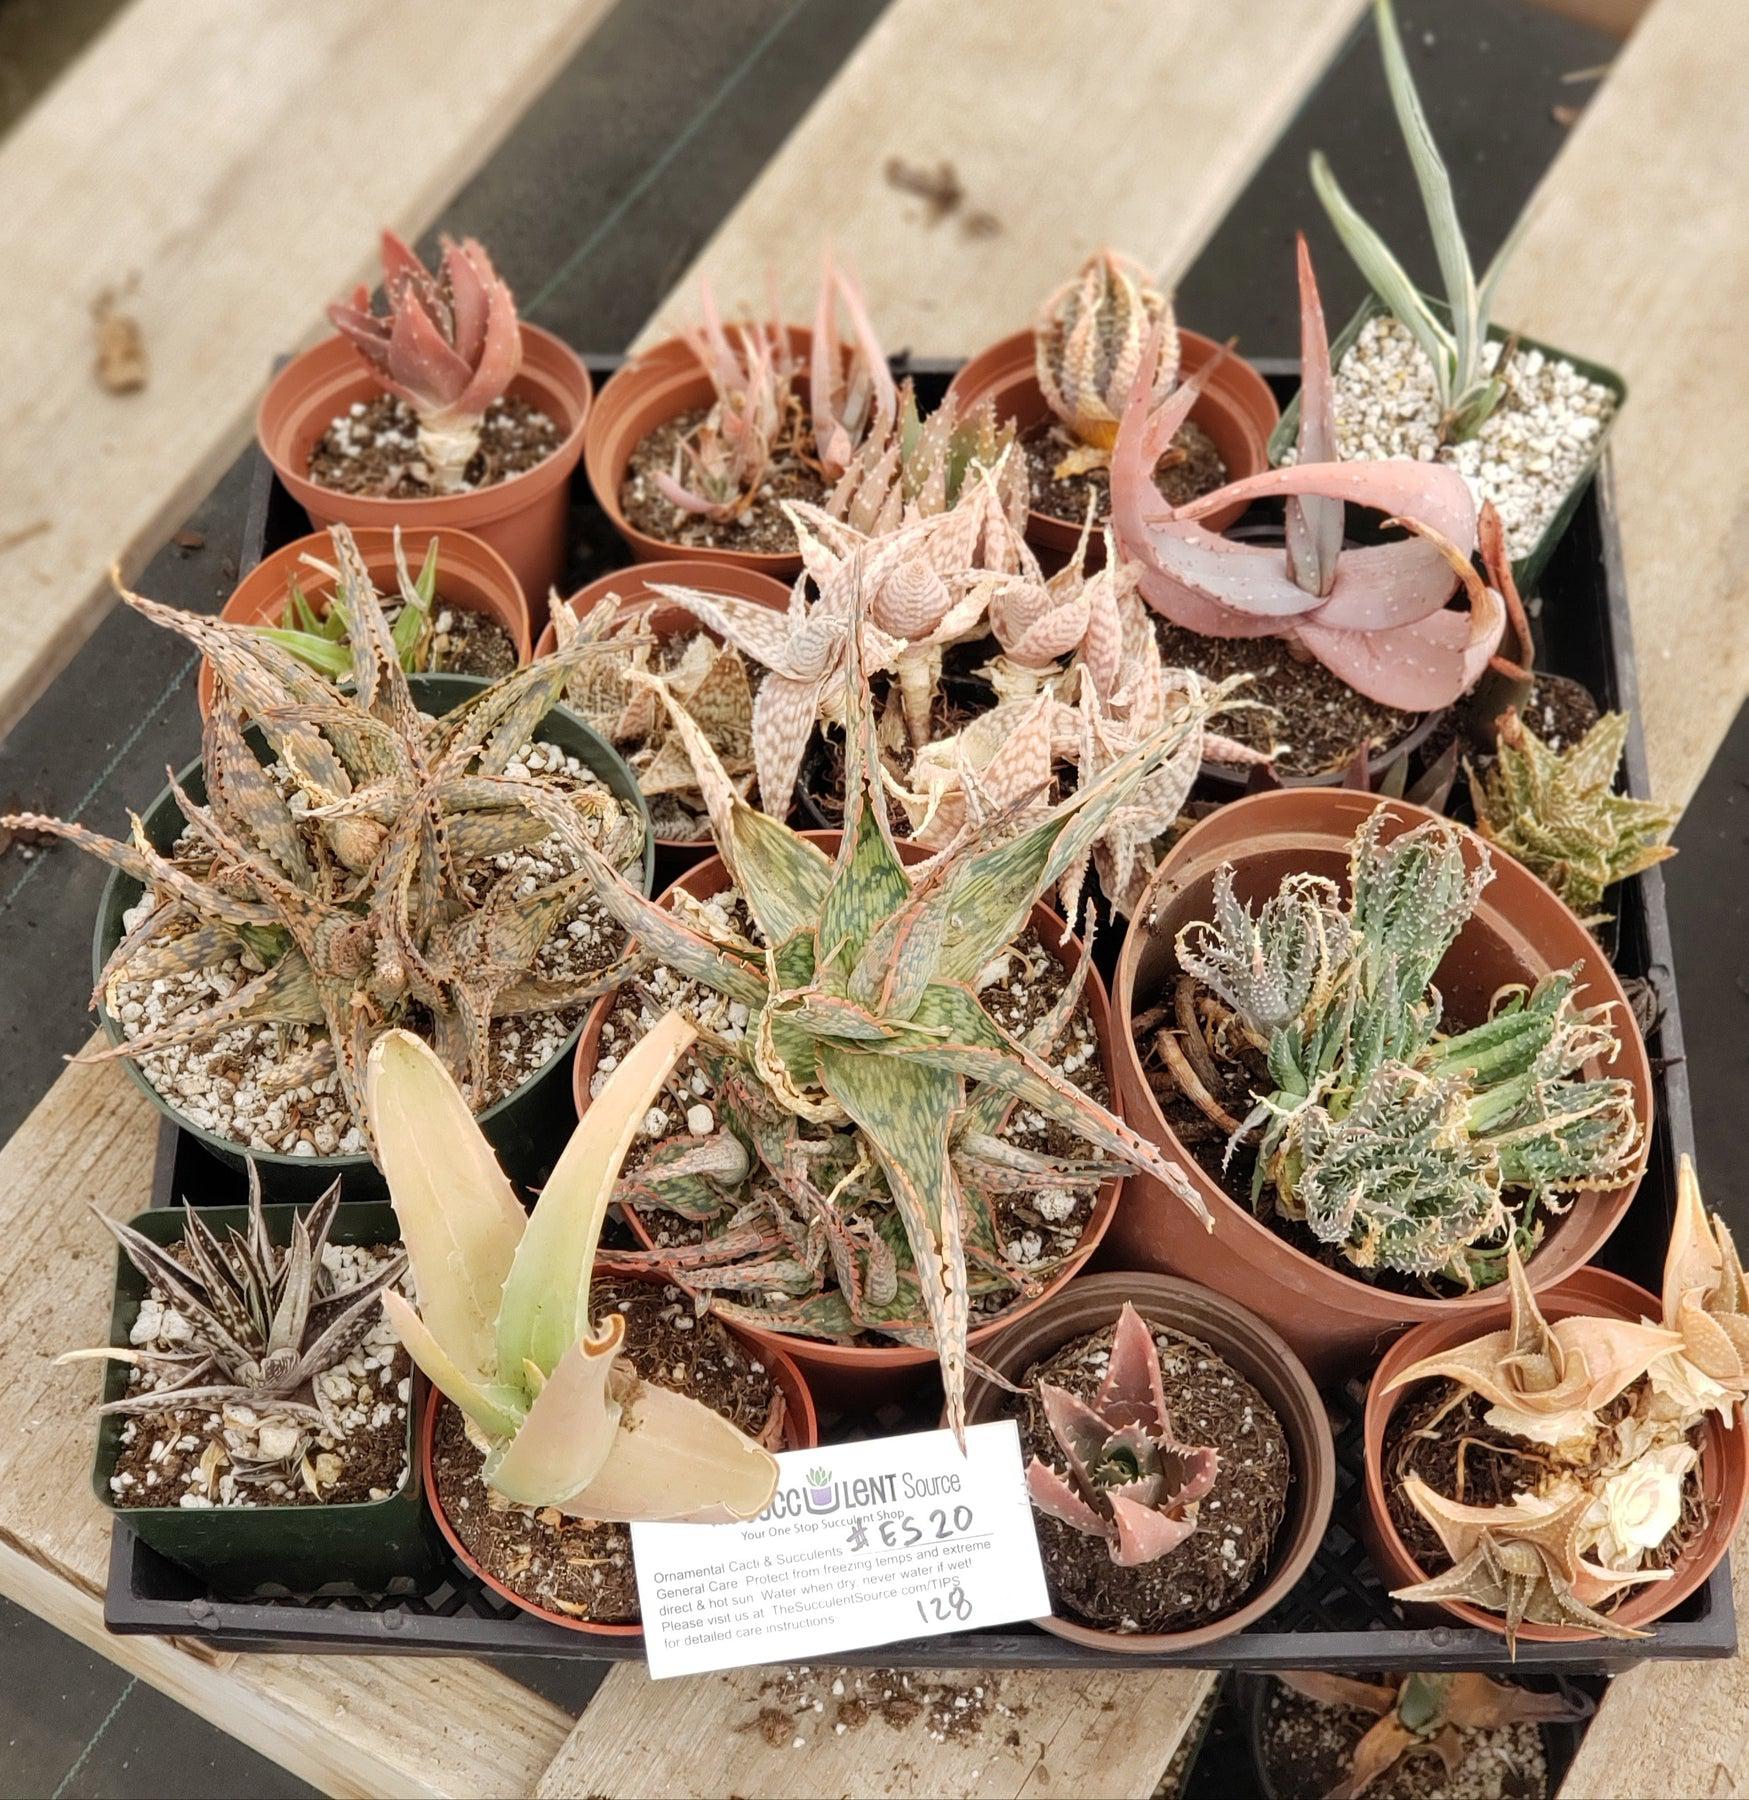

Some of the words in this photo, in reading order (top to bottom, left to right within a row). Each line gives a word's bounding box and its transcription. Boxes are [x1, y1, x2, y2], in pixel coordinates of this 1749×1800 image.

[902, 1472, 961, 1499] Source
[741, 1530, 765, 1541] Your
[768, 1523, 791, 1537] One
[794, 1521, 819, 1534] Stop
[821, 1513, 875, 1530] Succulnt
[877, 1508, 904, 1521] Shop
[654, 1563, 725, 1584] Ornamental
[729, 1559, 760, 1573] Cacti
[764, 1555, 773, 1567] &
[776, 1547, 843, 1566] Succulents
[656, 1583, 705, 1600] General
[746, 1571, 789, 1586] Protect
[793, 1568, 820, 1579] from
[823, 1559, 872, 1576] freezing
[876, 1552, 912, 1568] temps
[917, 1547, 939, 1560] and
[942, 1541, 991, 1556] extreme
[659, 1602, 693, 1617] direct
[696, 1599, 706, 1611] &
[709, 1597, 729, 1609] hot
[761, 1588, 797, 1601] Water
[801, 1582, 833, 1595] when
[863, 1572, 896, 1585] never
[900, 1566, 933, 1580] water
[937, 1562, 945, 1573] if
[948, 1558, 972, 1572] wet!
[917, 1586, 973, 1623] 128
[662, 1618, 704, 1632] Please
[707, 1612, 731, 1625] visit
[735, 1611, 749, 1622] us
[753, 1608, 765, 1619] at
[664, 1638, 679, 1649] for
[684, 1629, 732, 1646] detailed
[736, 1625, 762, 1639] care
